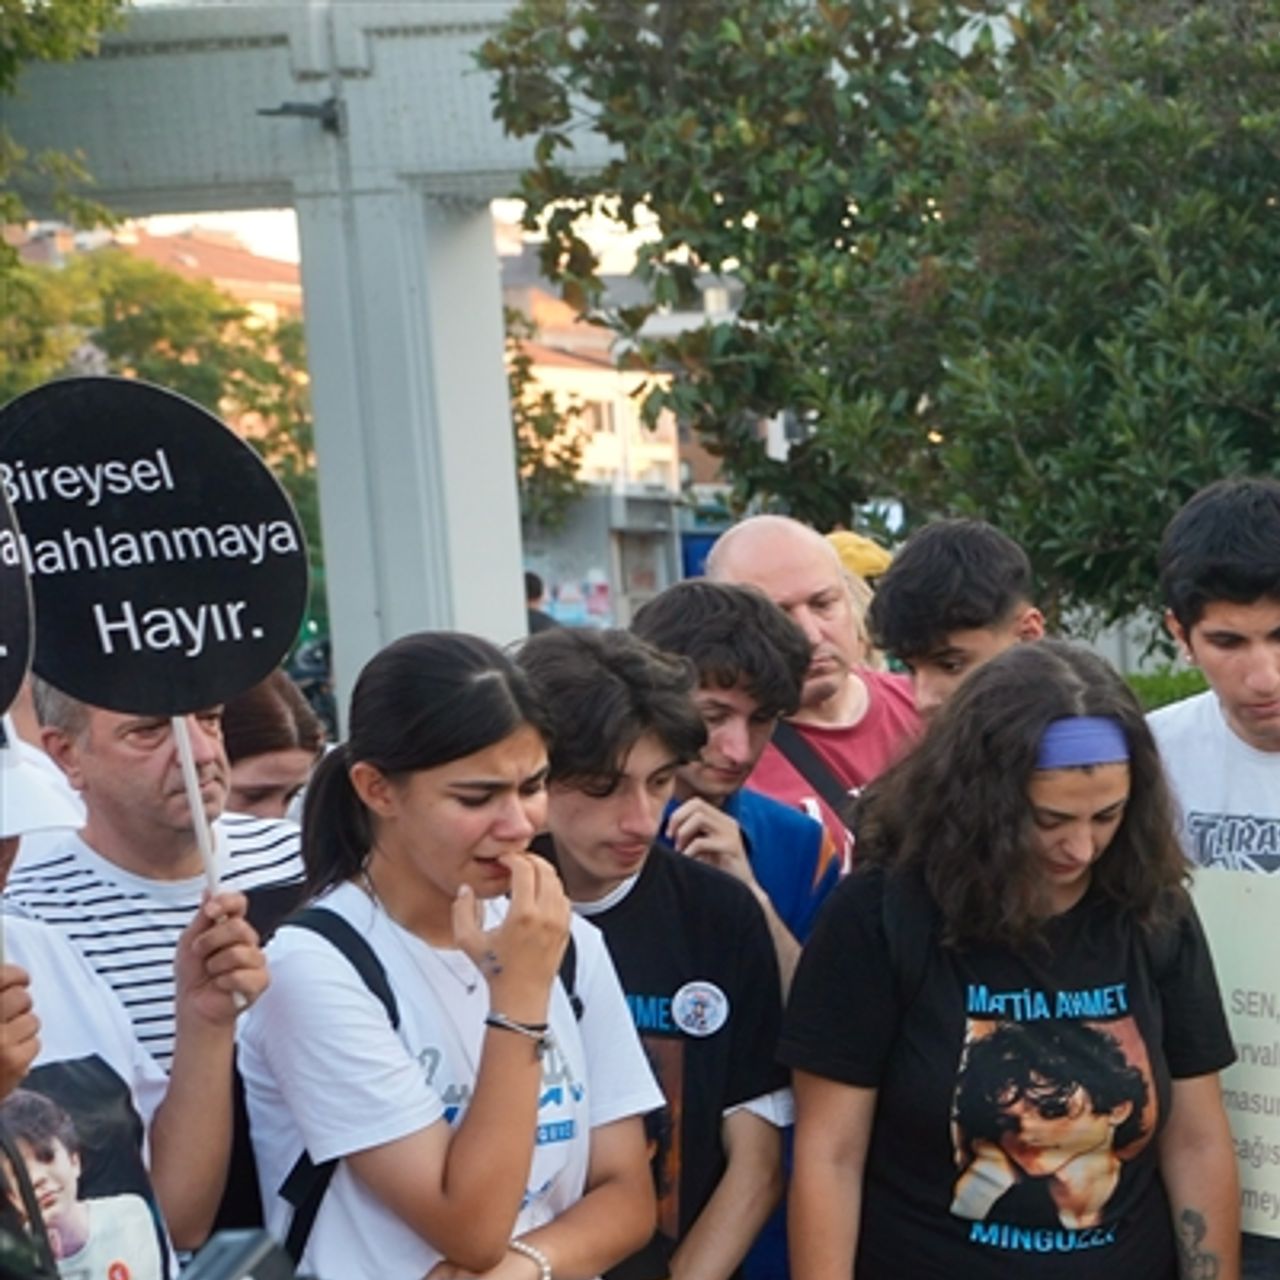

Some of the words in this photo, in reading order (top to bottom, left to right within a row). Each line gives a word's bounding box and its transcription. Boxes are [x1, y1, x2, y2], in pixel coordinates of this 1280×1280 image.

[0, 448, 174, 506] Bireysel
[20, 516, 299, 574] lahlanmaya
[93, 599, 265, 658] Hayır.
[1055, 982, 1128, 1019] AHMET
